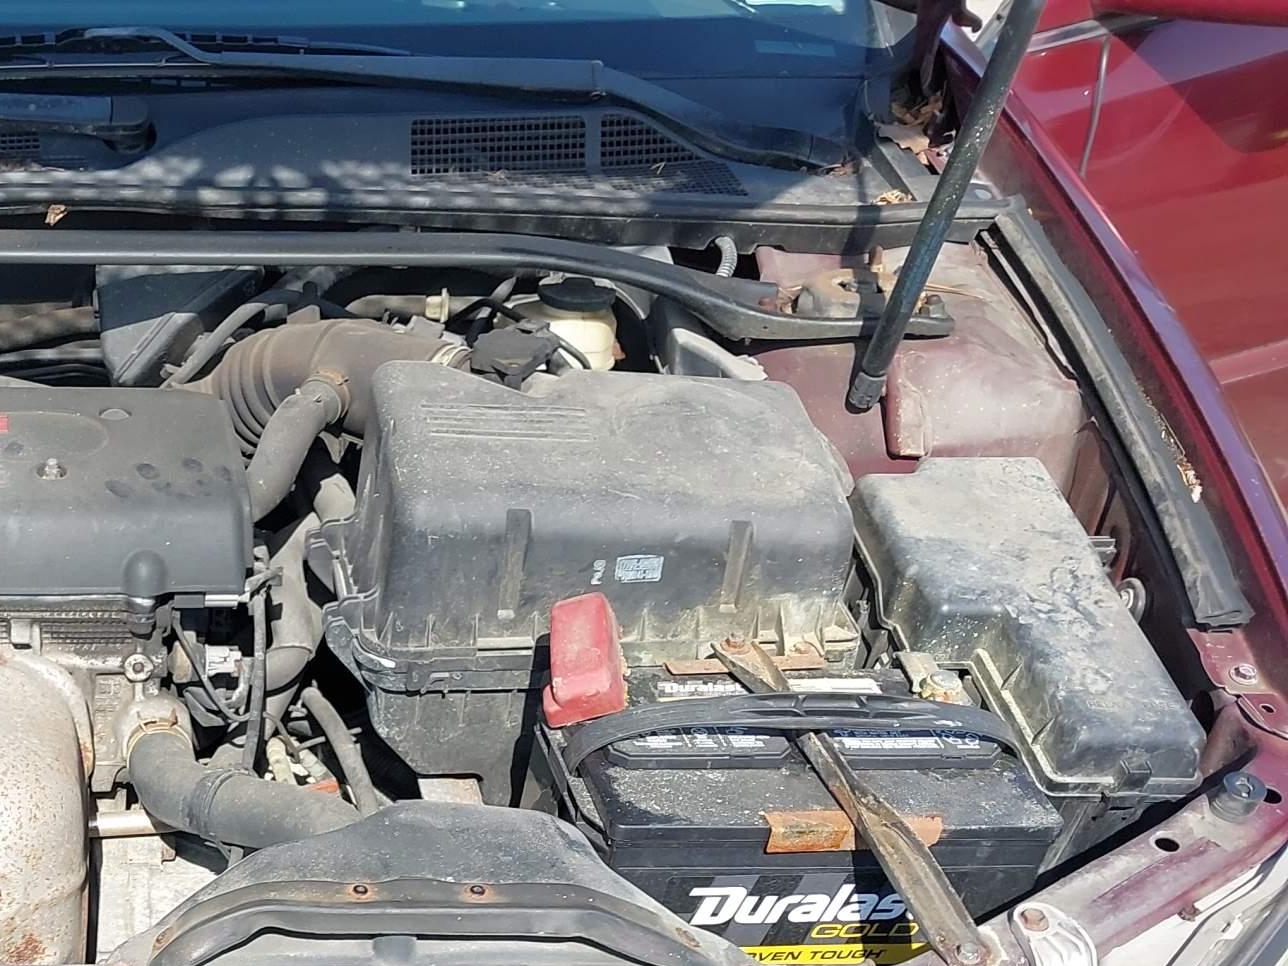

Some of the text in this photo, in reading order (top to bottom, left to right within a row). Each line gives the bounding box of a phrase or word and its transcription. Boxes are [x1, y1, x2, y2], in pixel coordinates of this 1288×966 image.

[689, 884, 914, 926] Duralas
[811, 923, 920, 939] GOLD
[746, 949, 884, 962] VEN TOUGH
